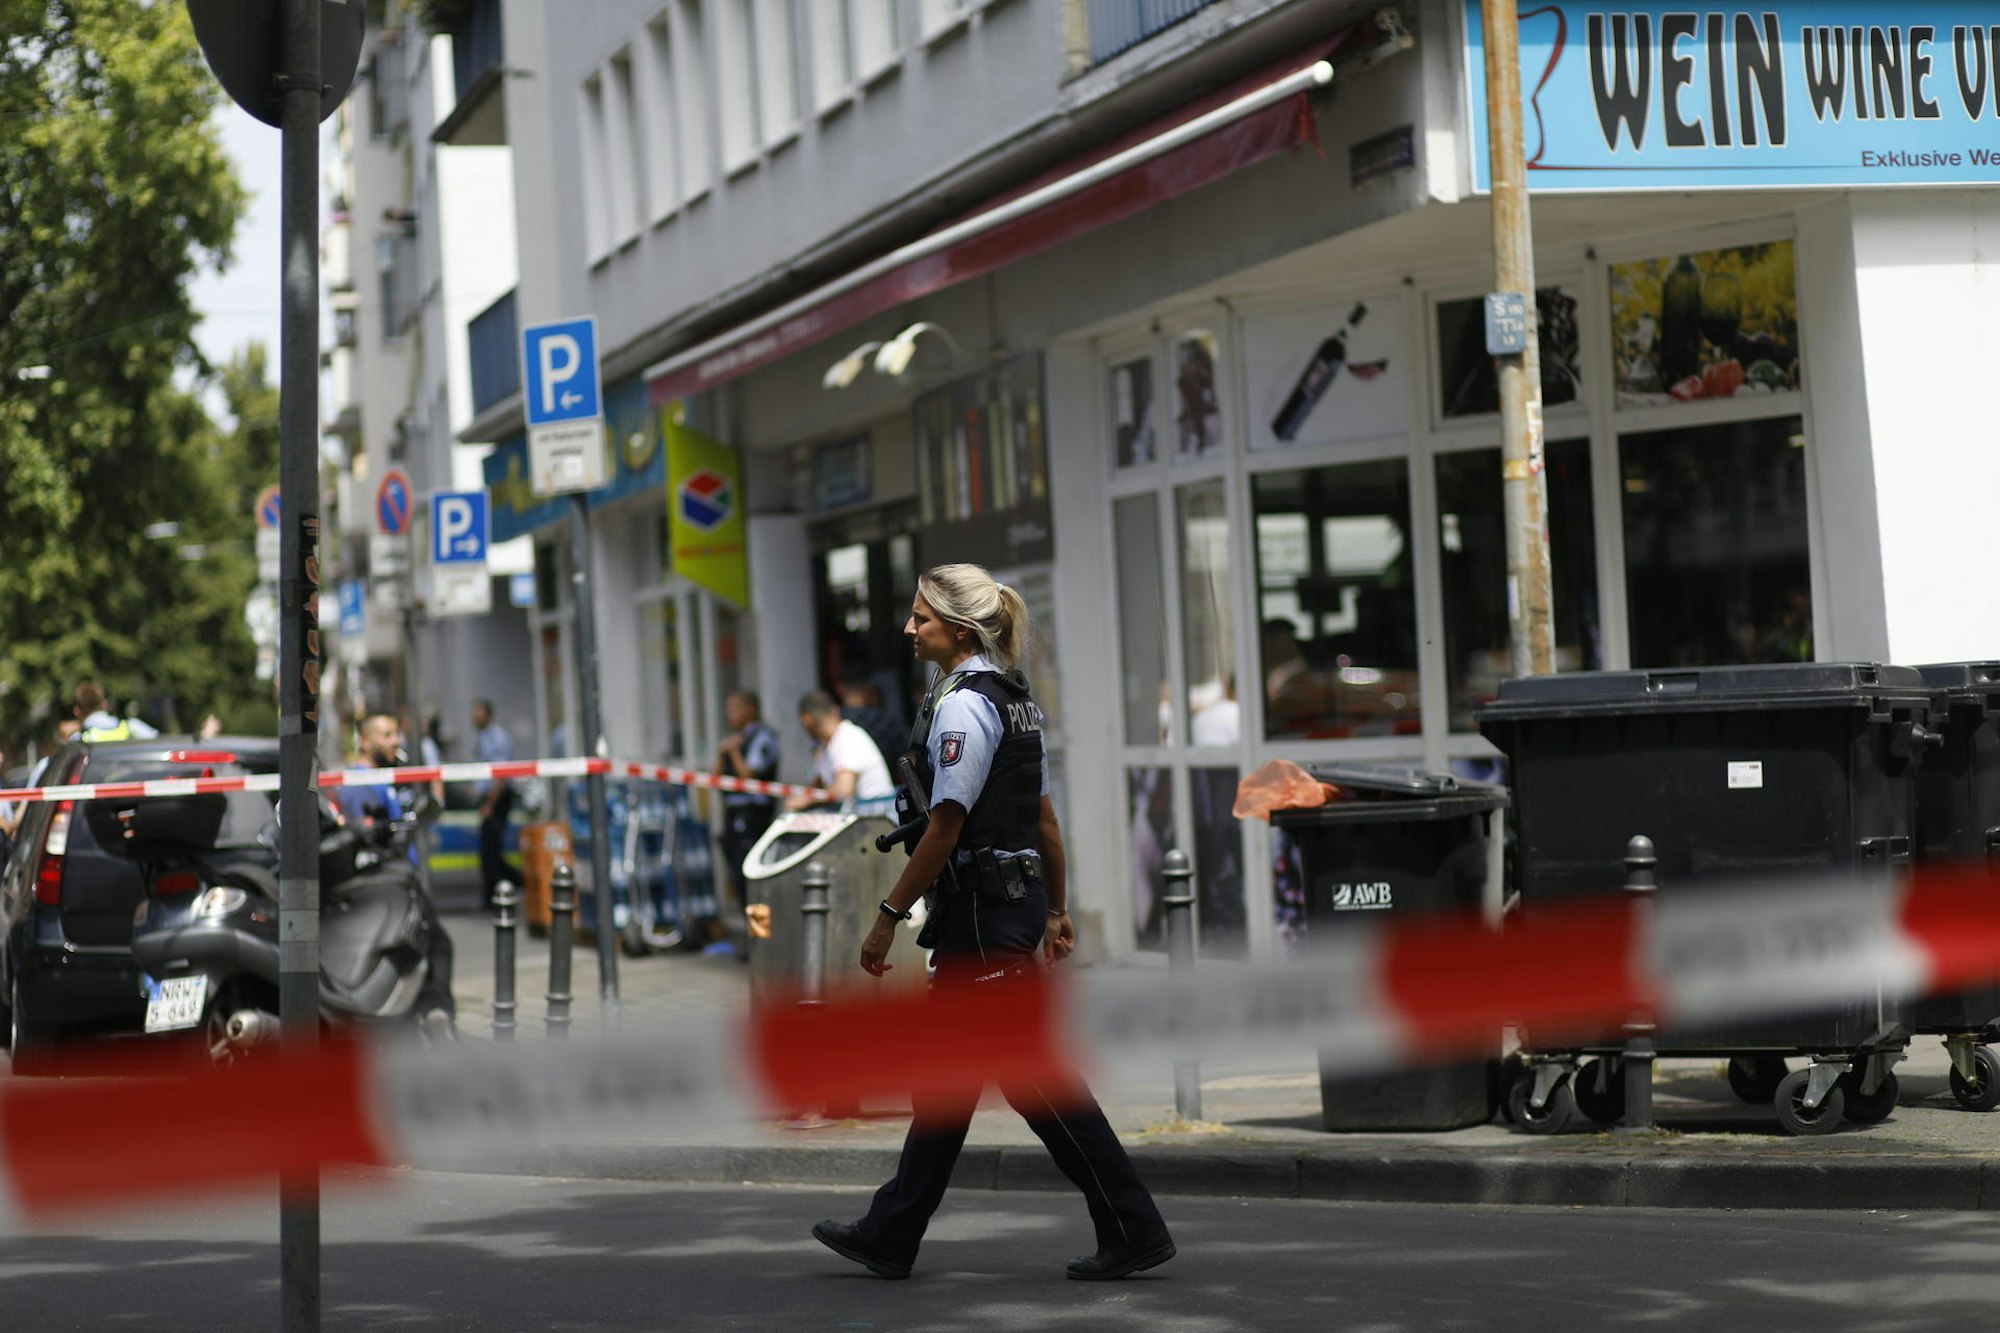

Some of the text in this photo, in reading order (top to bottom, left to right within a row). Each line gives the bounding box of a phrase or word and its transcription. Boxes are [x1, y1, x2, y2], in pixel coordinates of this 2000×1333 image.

[1587, 12, 1787, 153] WEIN
[1802, 25, 1942, 123] WINE
[1861, 150, 1962, 168] Exklusive
[539, 333, 580, 414] P
[440, 498, 472, 559] P
[1353, 882, 1392, 904] AWB
